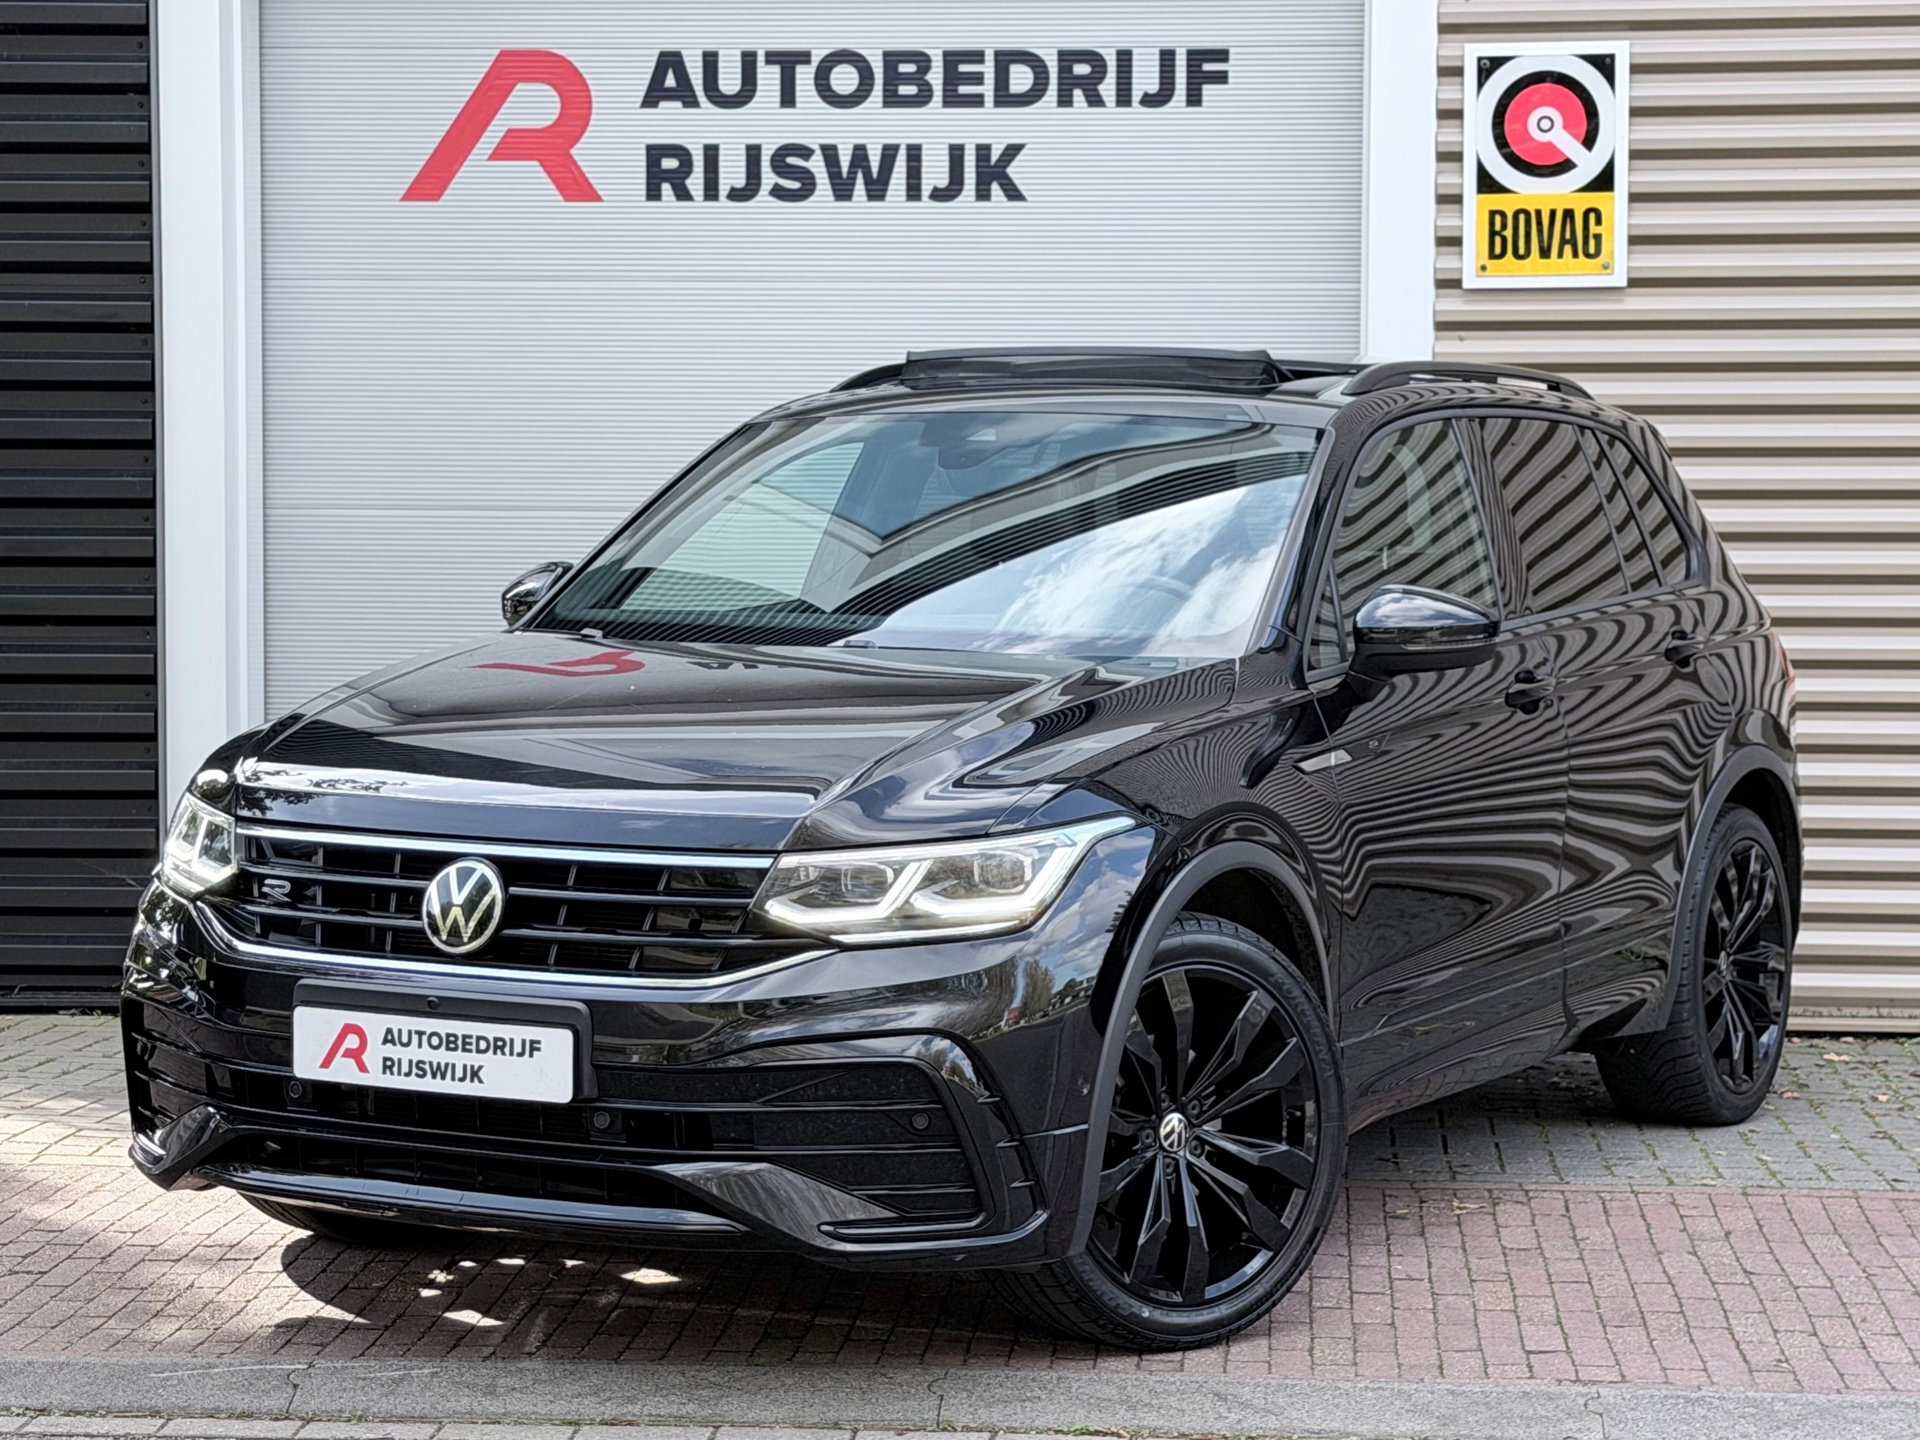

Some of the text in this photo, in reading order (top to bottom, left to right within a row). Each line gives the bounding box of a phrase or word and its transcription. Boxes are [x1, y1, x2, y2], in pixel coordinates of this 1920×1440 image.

[640, 48, 1230, 109] AUTOBEDRIJF
[645, 143, 1027, 203] RIJSWIJK
[1488, 207, 1603, 261] BOVAG
[381, 1026, 542, 1058] AUTOBEDRIJF
[381, 1056, 485, 1085] RIJSWIJK
